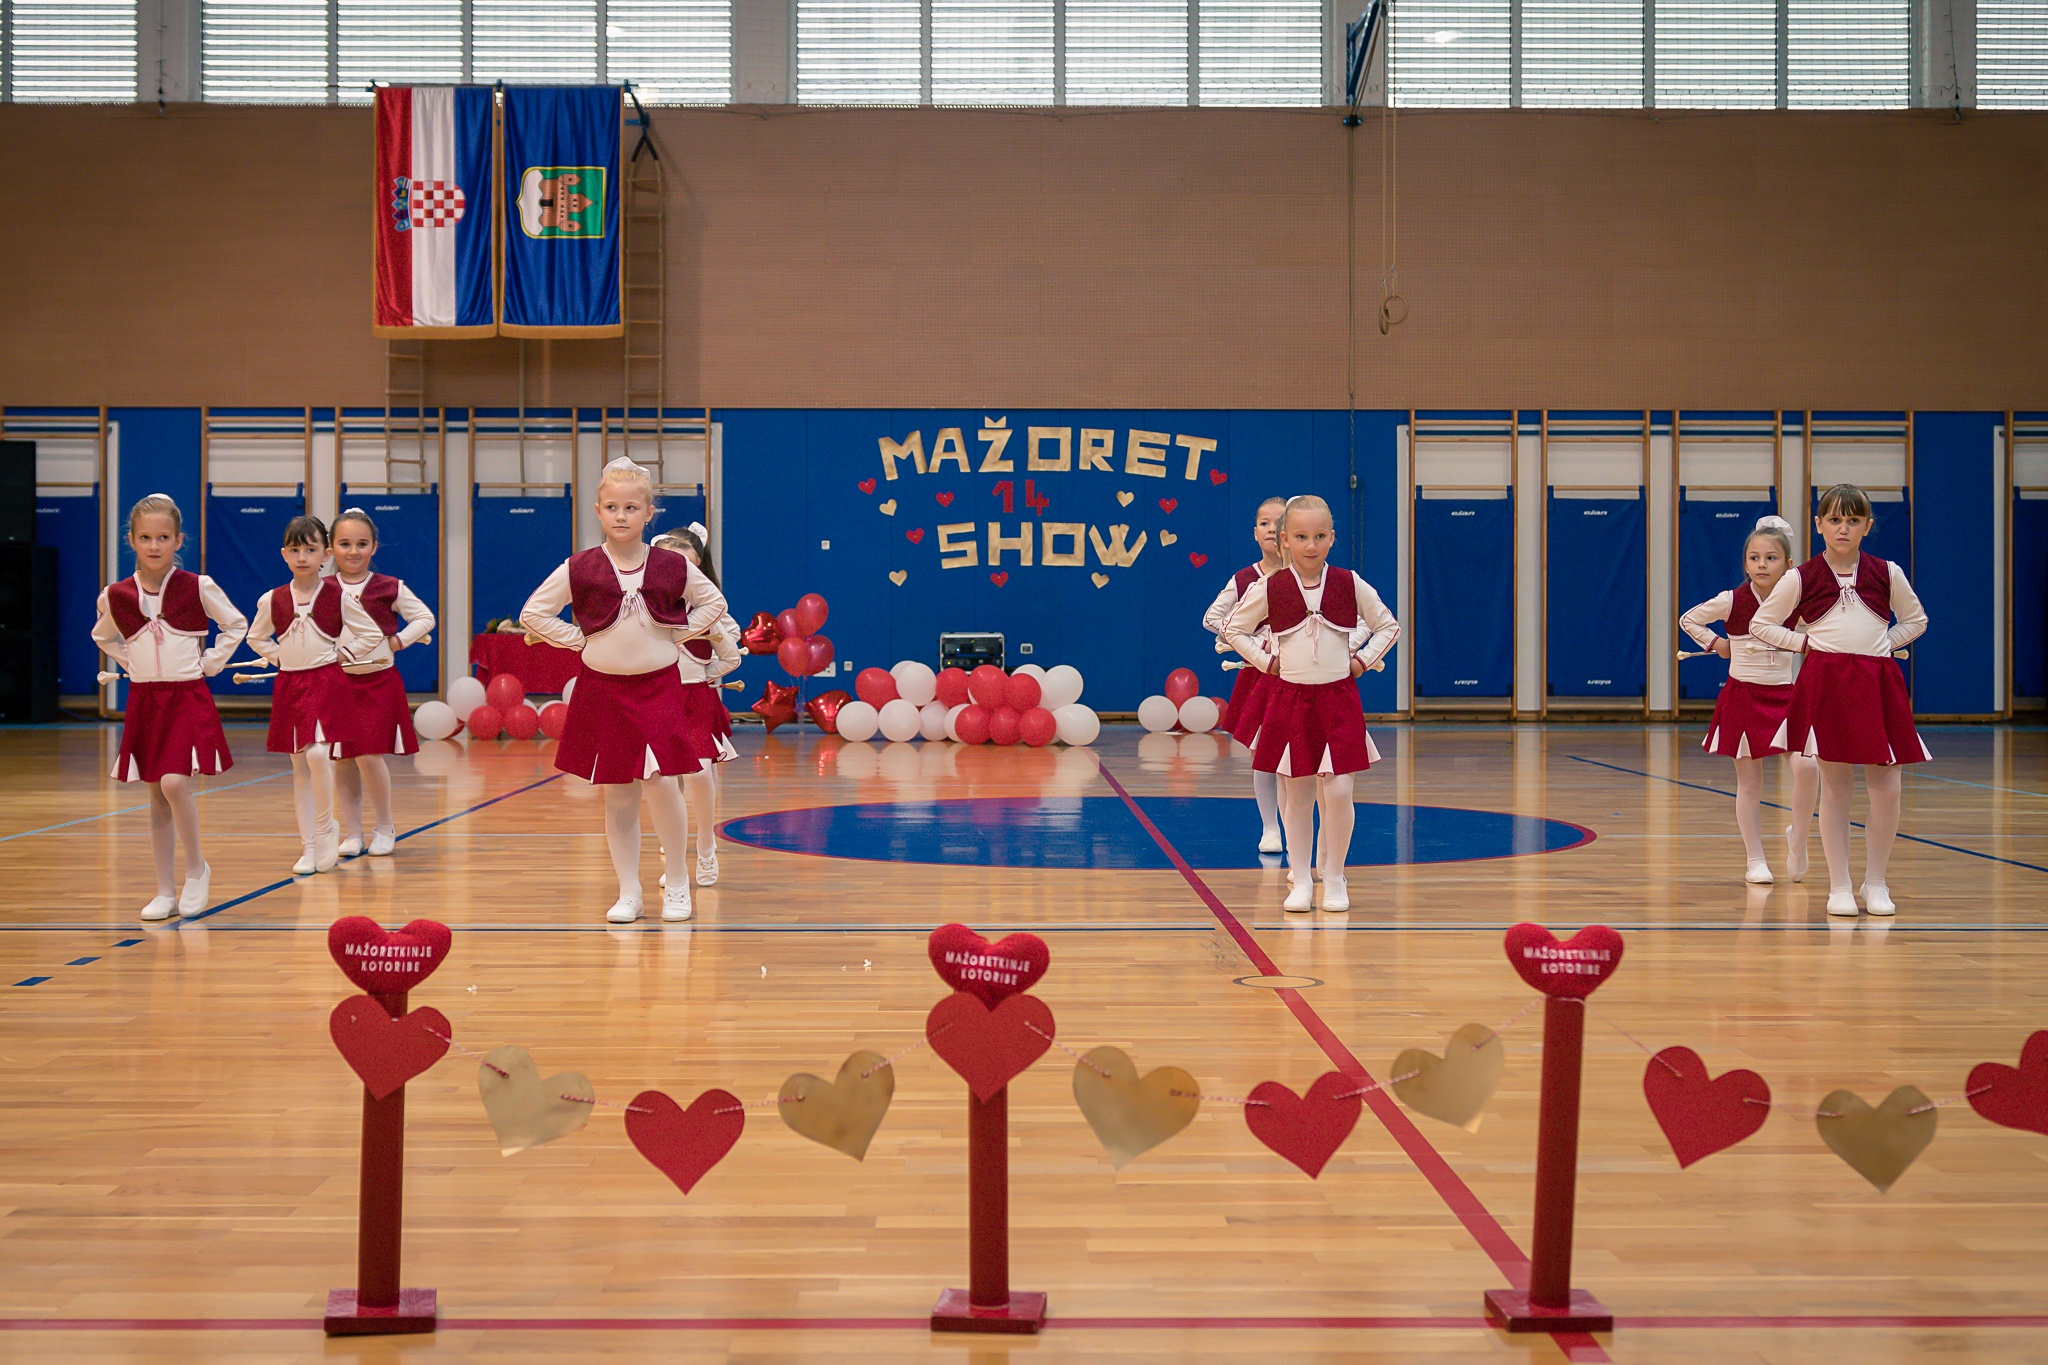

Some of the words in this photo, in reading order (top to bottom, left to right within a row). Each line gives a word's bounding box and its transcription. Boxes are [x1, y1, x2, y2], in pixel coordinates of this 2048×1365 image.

[878, 415, 1218, 481] MAŽORET
[991, 479, 1050, 516] 14
[937, 521, 1148, 569] SHOW
[344, 942, 432, 958] MAŽORETKINJE
[361, 961, 420, 973] KOTORIBE
[960, 968, 1018, 985] KOTORIBE
